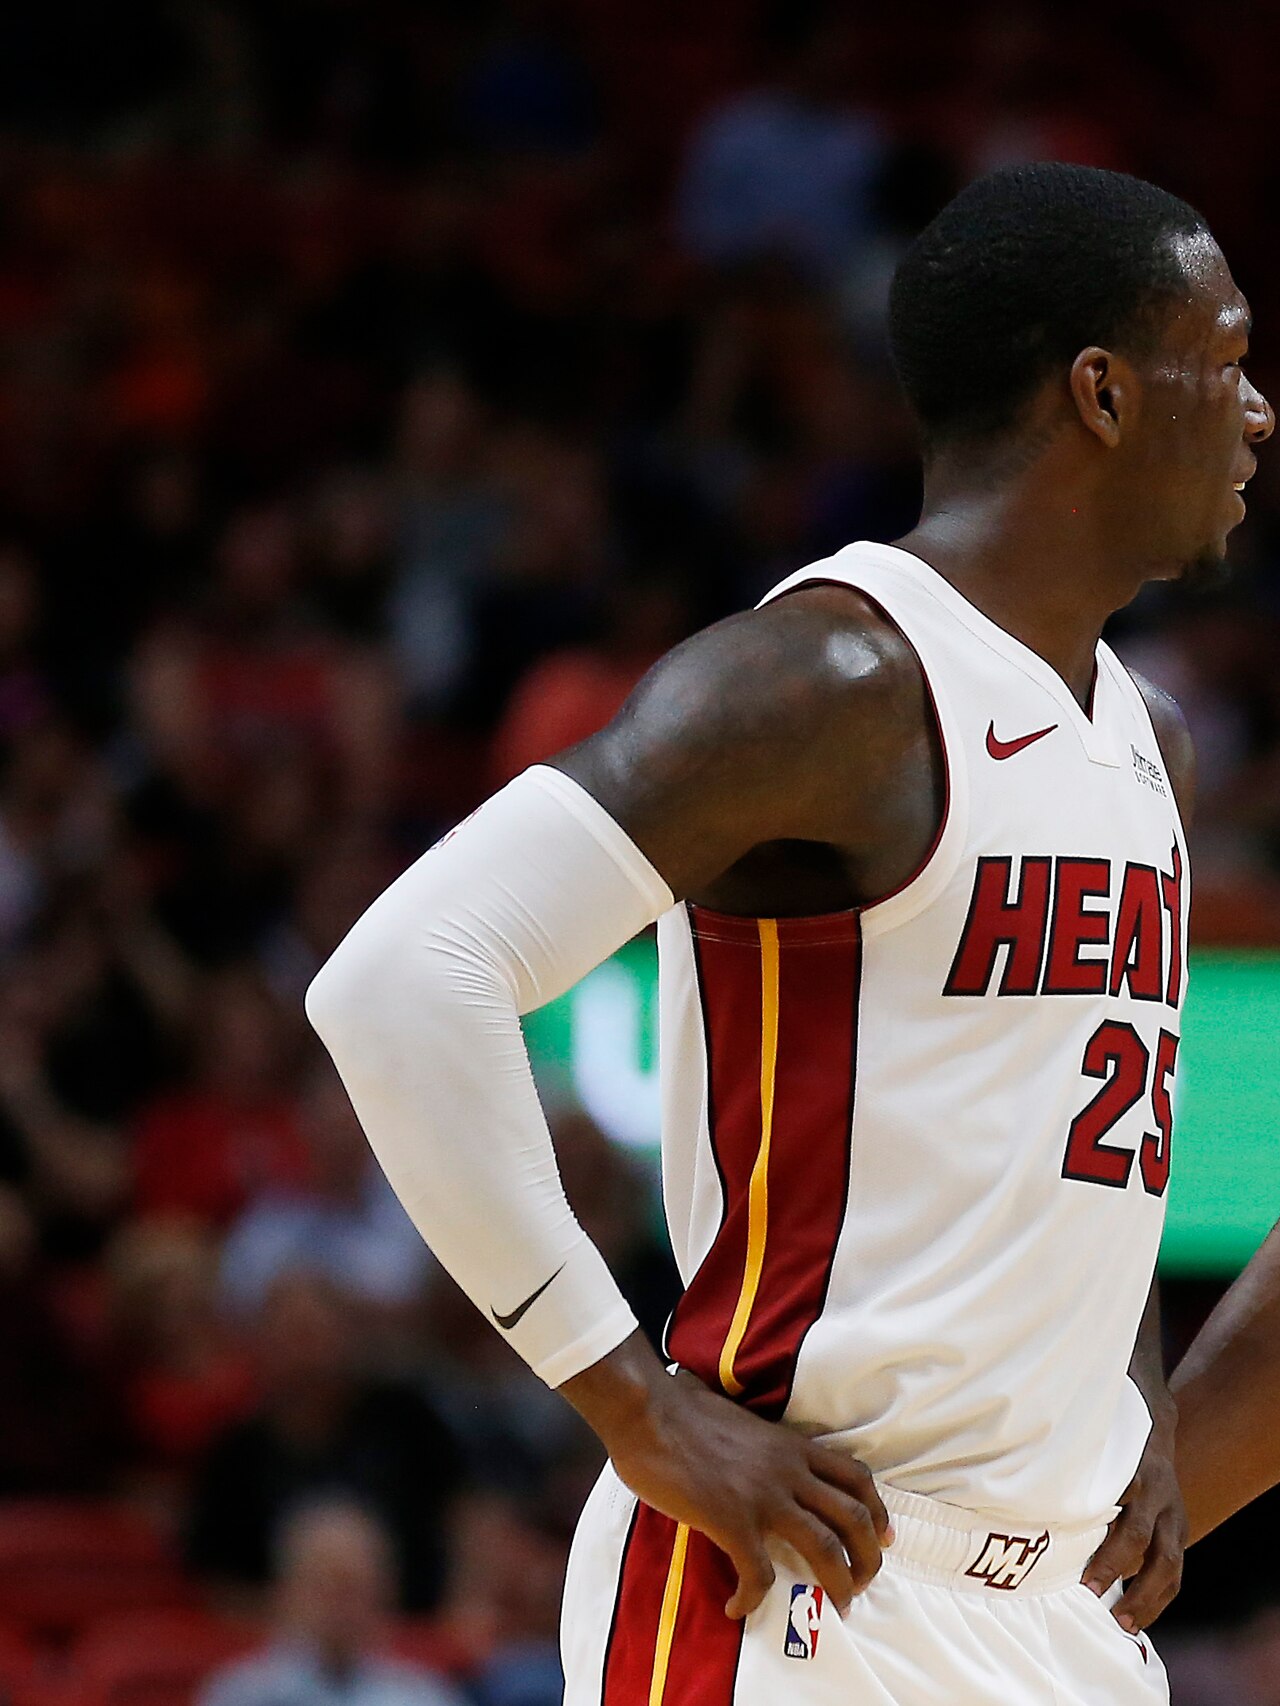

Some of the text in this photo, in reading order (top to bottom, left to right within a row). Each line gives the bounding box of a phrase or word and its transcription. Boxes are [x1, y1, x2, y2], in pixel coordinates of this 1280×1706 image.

[942, 830, 1181, 1010] HEAT
[1061, 1018, 1180, 1198] 25
[786, 1641, 805, 1657] NBA
